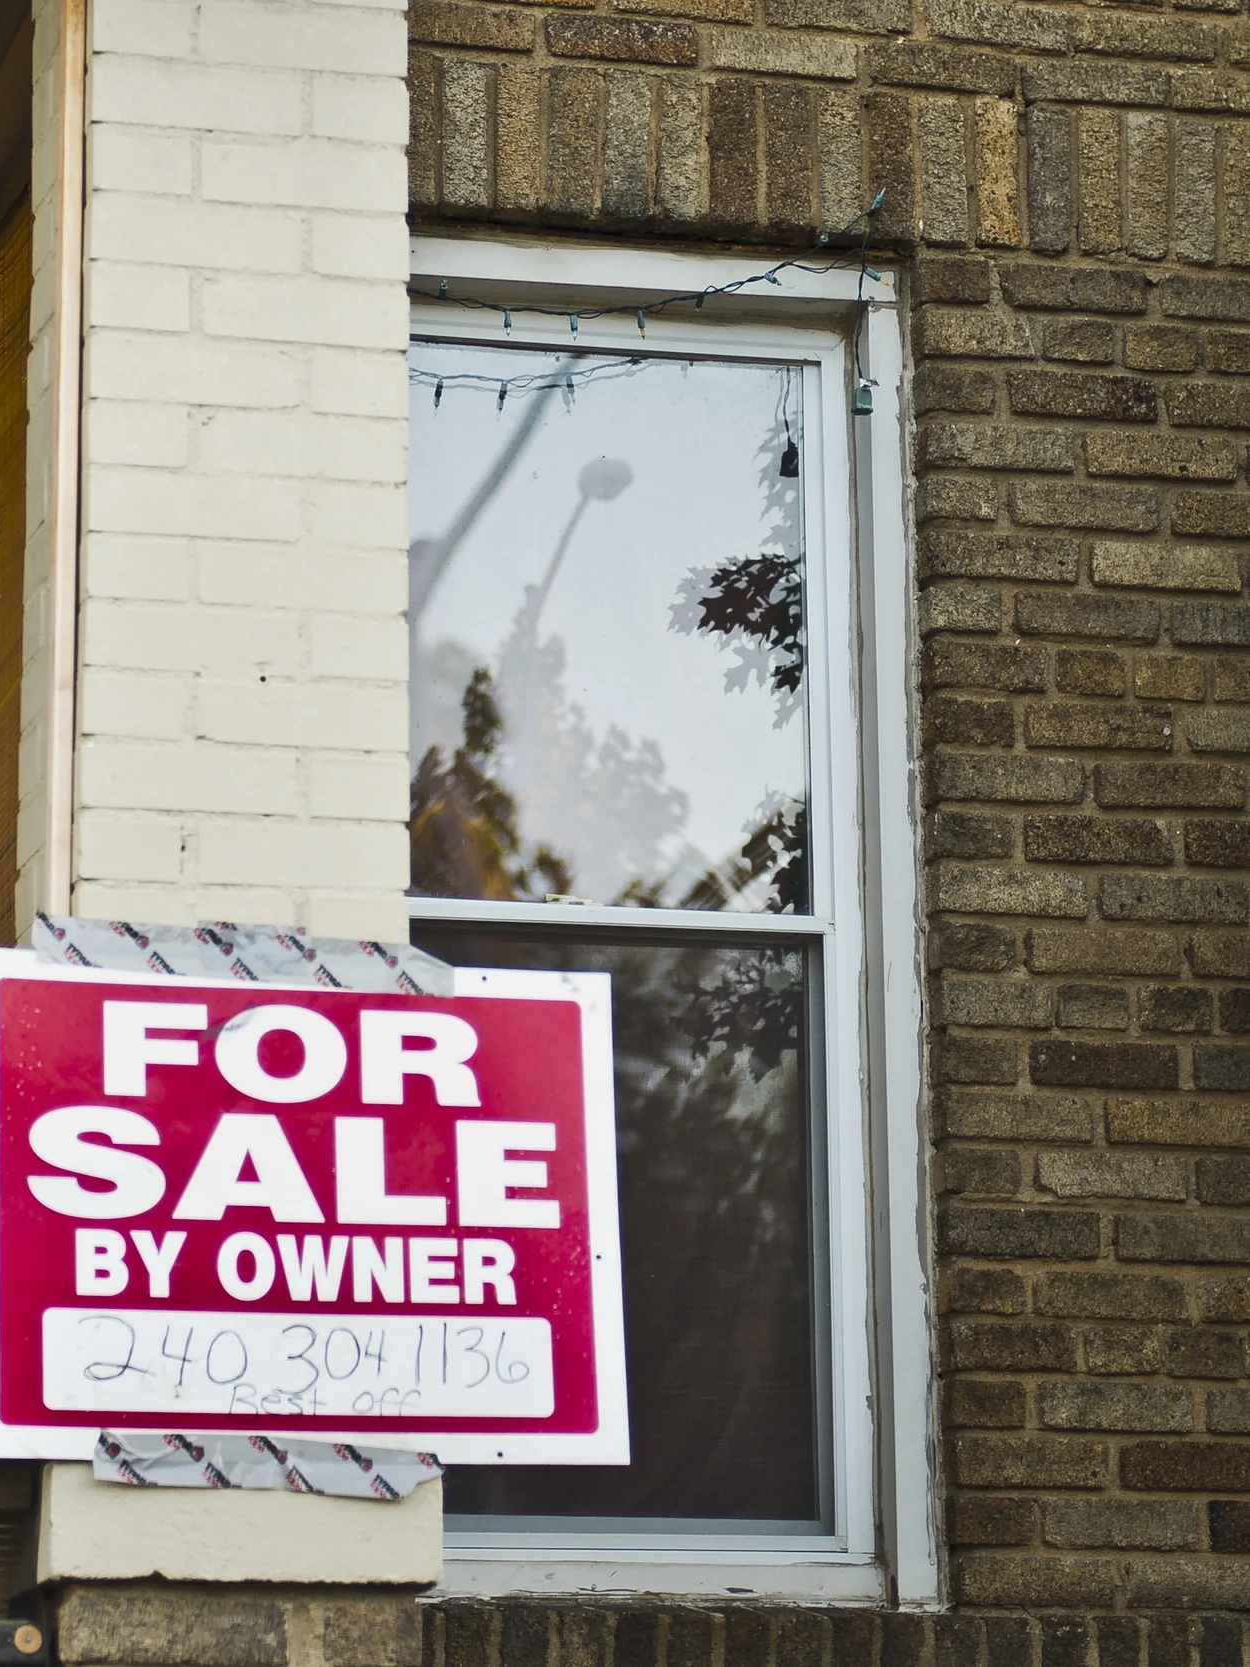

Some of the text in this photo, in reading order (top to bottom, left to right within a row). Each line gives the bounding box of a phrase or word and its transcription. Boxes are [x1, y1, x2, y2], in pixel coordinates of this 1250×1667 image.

[103, 1000, 481, 1108] FOR
[27, 1105, 562, 1229] SALE
[75, 1228, 518, 1305] BY OWNER
[78, 1315, 531, 1395] 240 304 1136
[229, 1382, 327, 1421] Best
